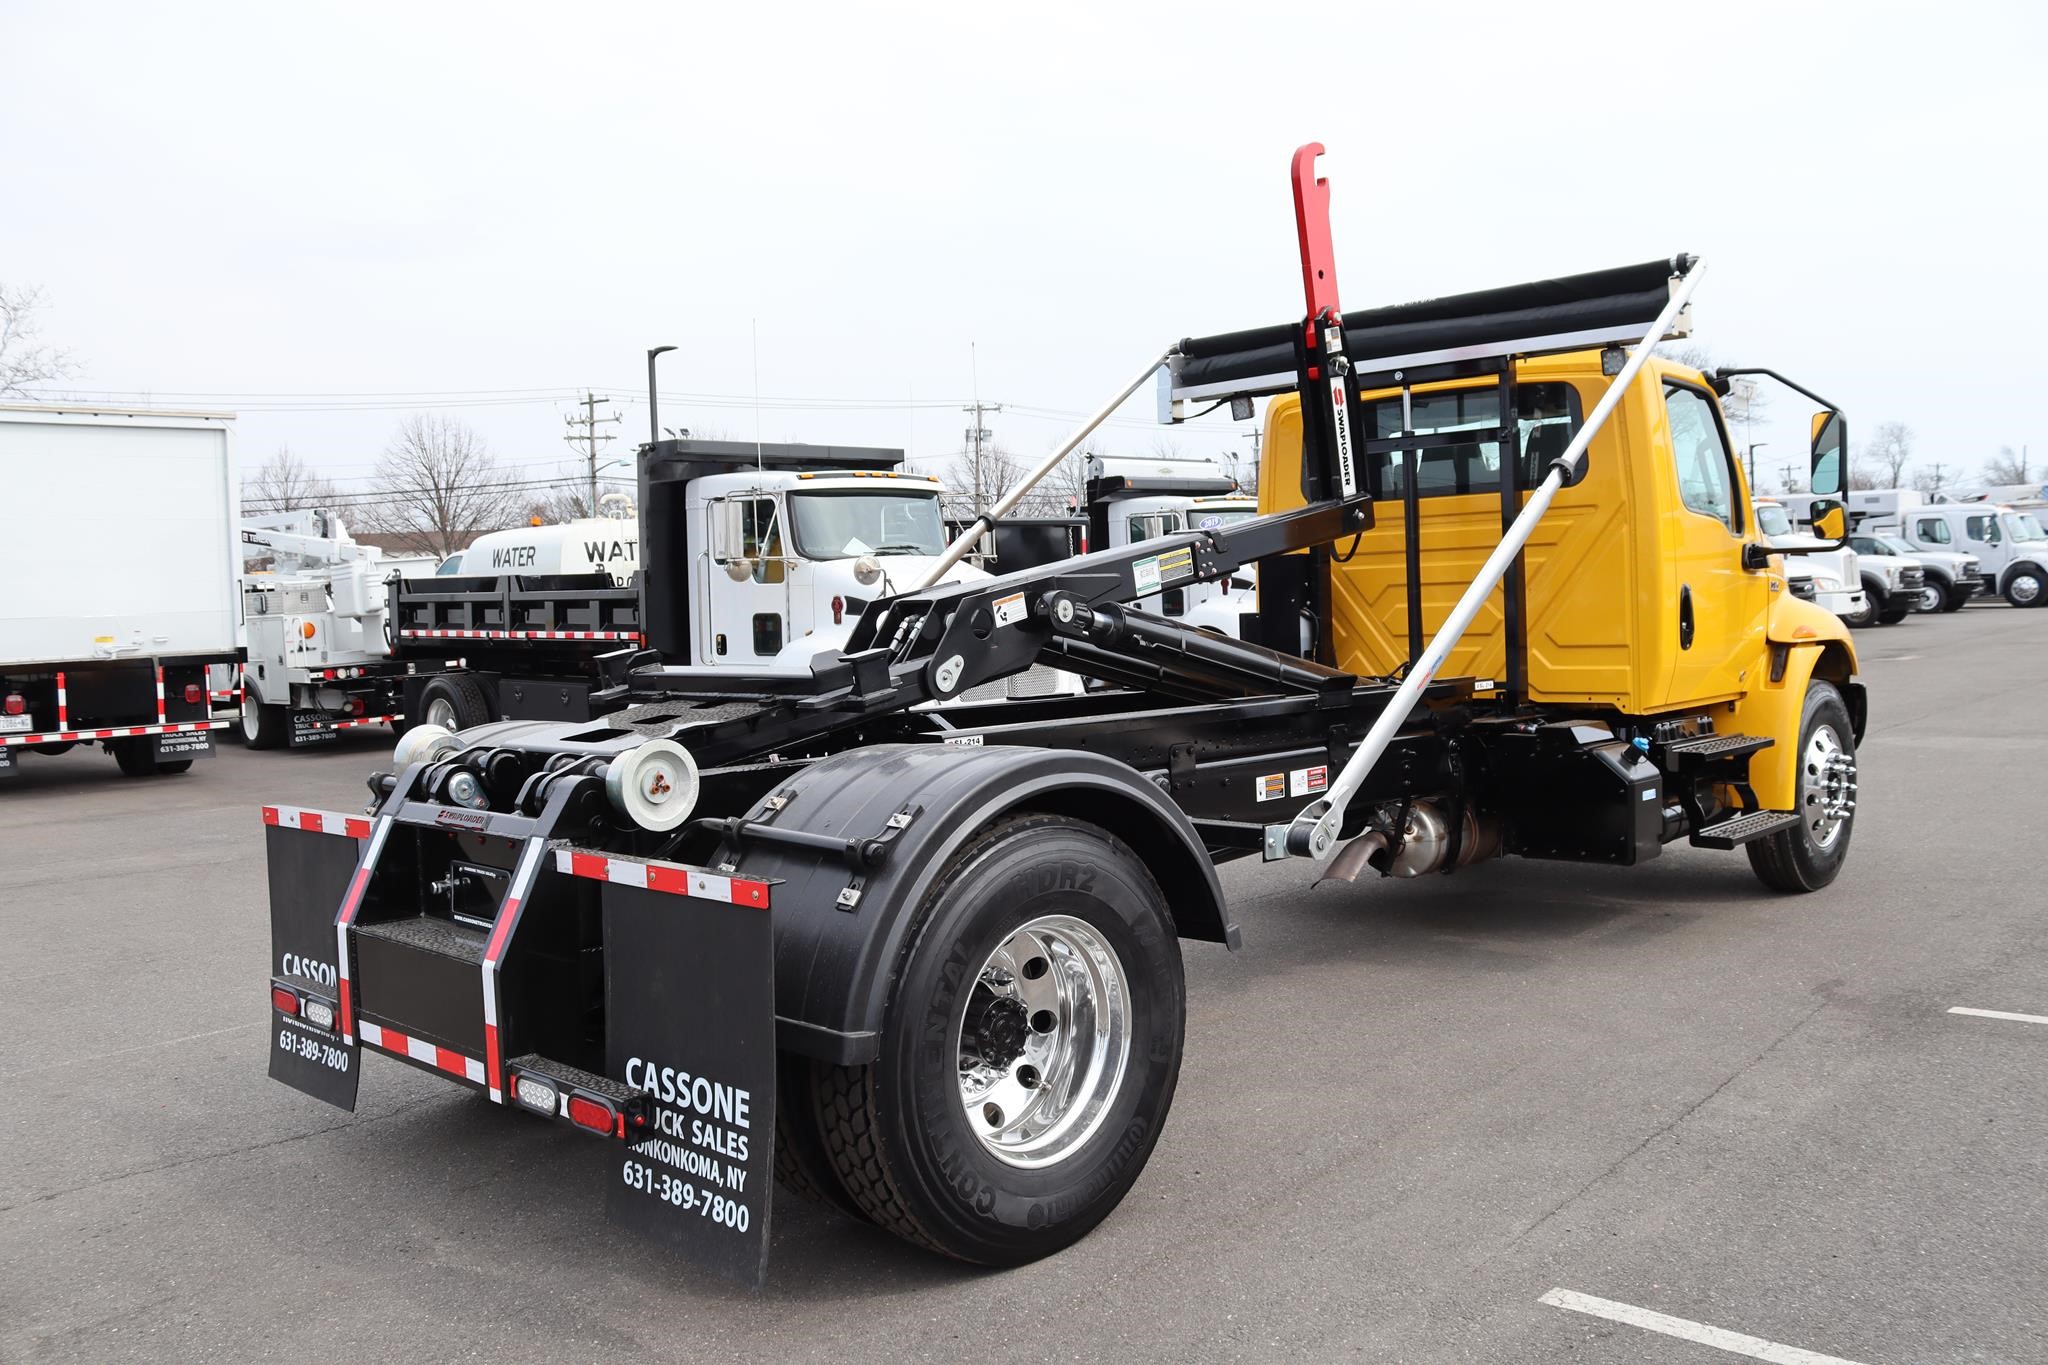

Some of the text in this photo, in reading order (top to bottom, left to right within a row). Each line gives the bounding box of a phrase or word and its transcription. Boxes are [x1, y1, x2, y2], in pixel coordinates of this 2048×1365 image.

[1336, 408, 1351, 486] SWAPLOADER
[492, 546, 536, 568] WATER
[160, 743, 209, 753] 631-389-7800
[444, 811, 485, 824] SWAPLOADER
[282, 953, 337, 988] CASSON
[280, 1030, 349, 1073] 631-389-7800
[625, 1057, 750, 1129] CASSONE
[653, 1107, 749, 1162] UCK SALES
[628, 1138, 747, 1193] ONKONKOMA, NY
[623, 1160, 750, 1233] 631-389-7800
